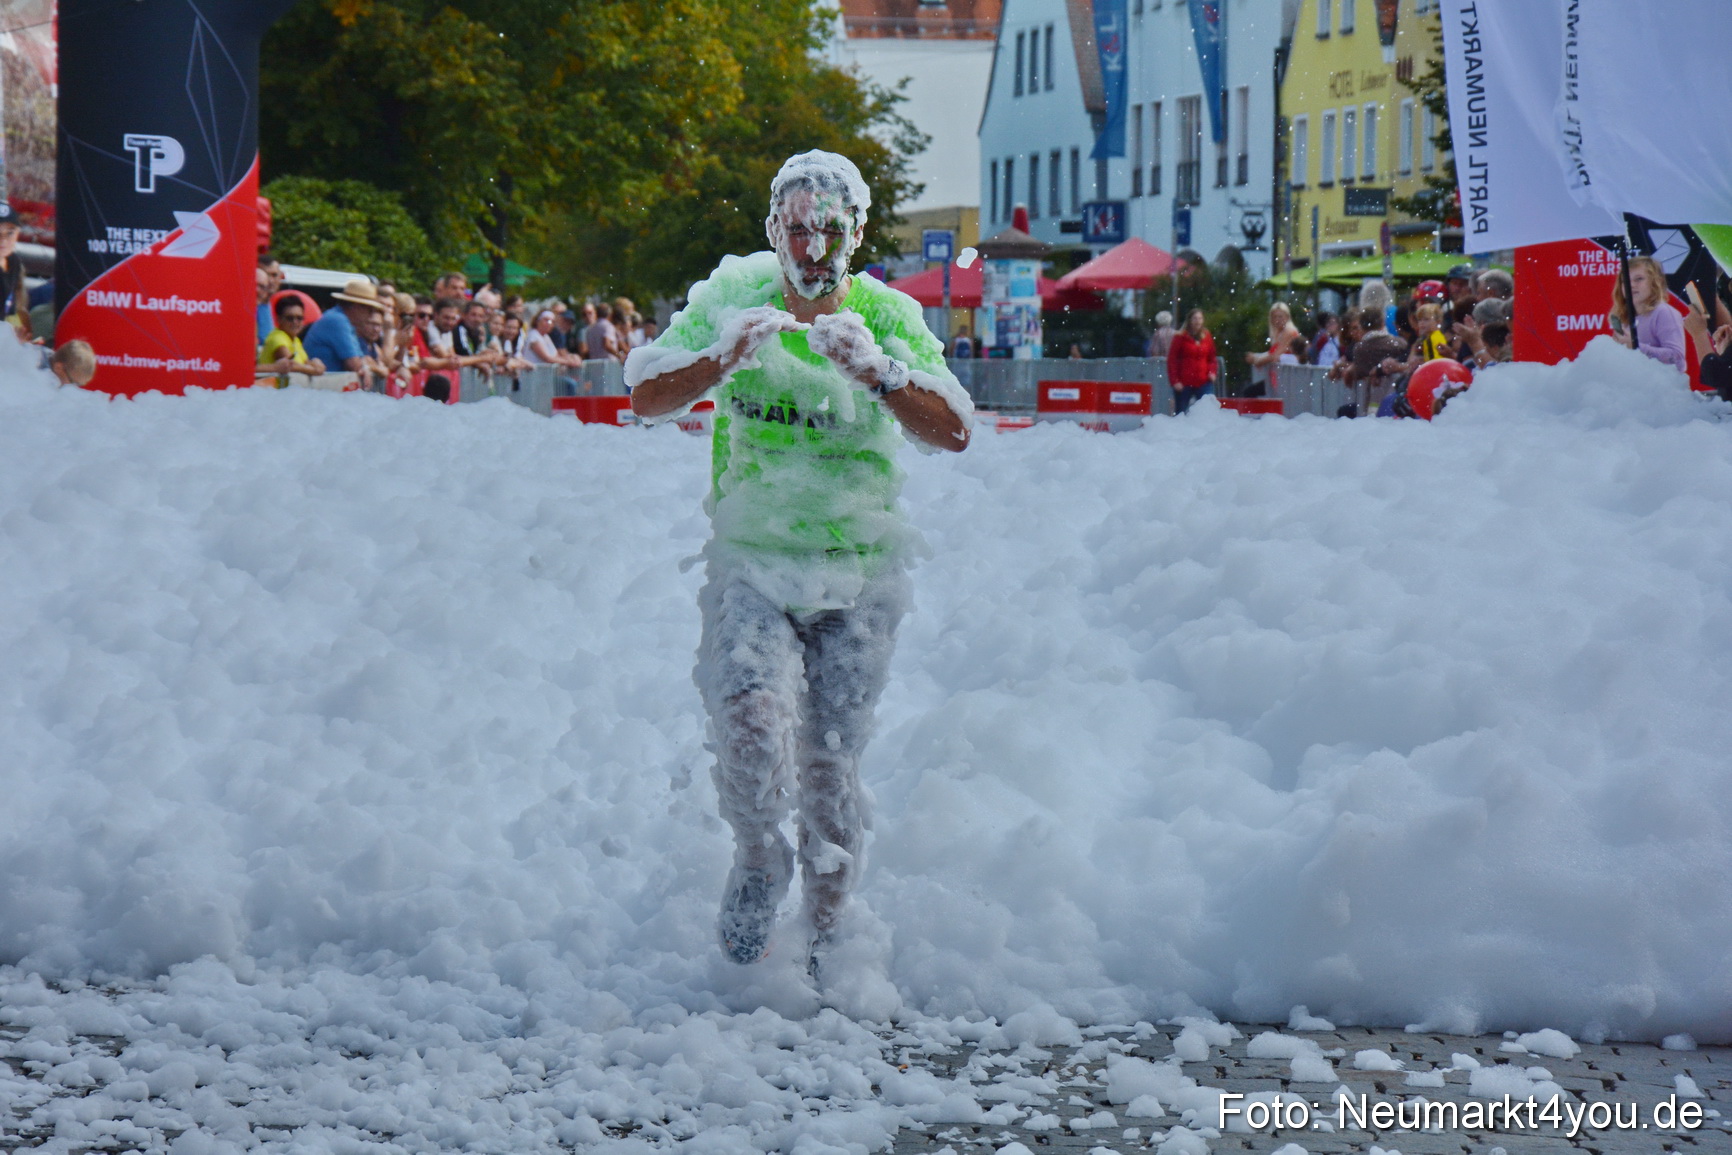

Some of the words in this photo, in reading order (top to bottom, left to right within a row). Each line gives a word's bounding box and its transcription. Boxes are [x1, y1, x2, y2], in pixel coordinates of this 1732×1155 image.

[105, 226, 131, 241] THE
[133, 228, 167, 243] NEXT
[87, 240, 107, 253] 100
[109, 241, 152, 256] YEARS
[1578, 251, 1604, 263] THE
[1558, 264, 1579, 277] 100
[86, 289, 132, 308] BMW
[135, 293, 222, 316] Laufsport
[1556, 314, 1605, 331] BMW
[95, 353, 221, 372] ww.bmw-partl.de
